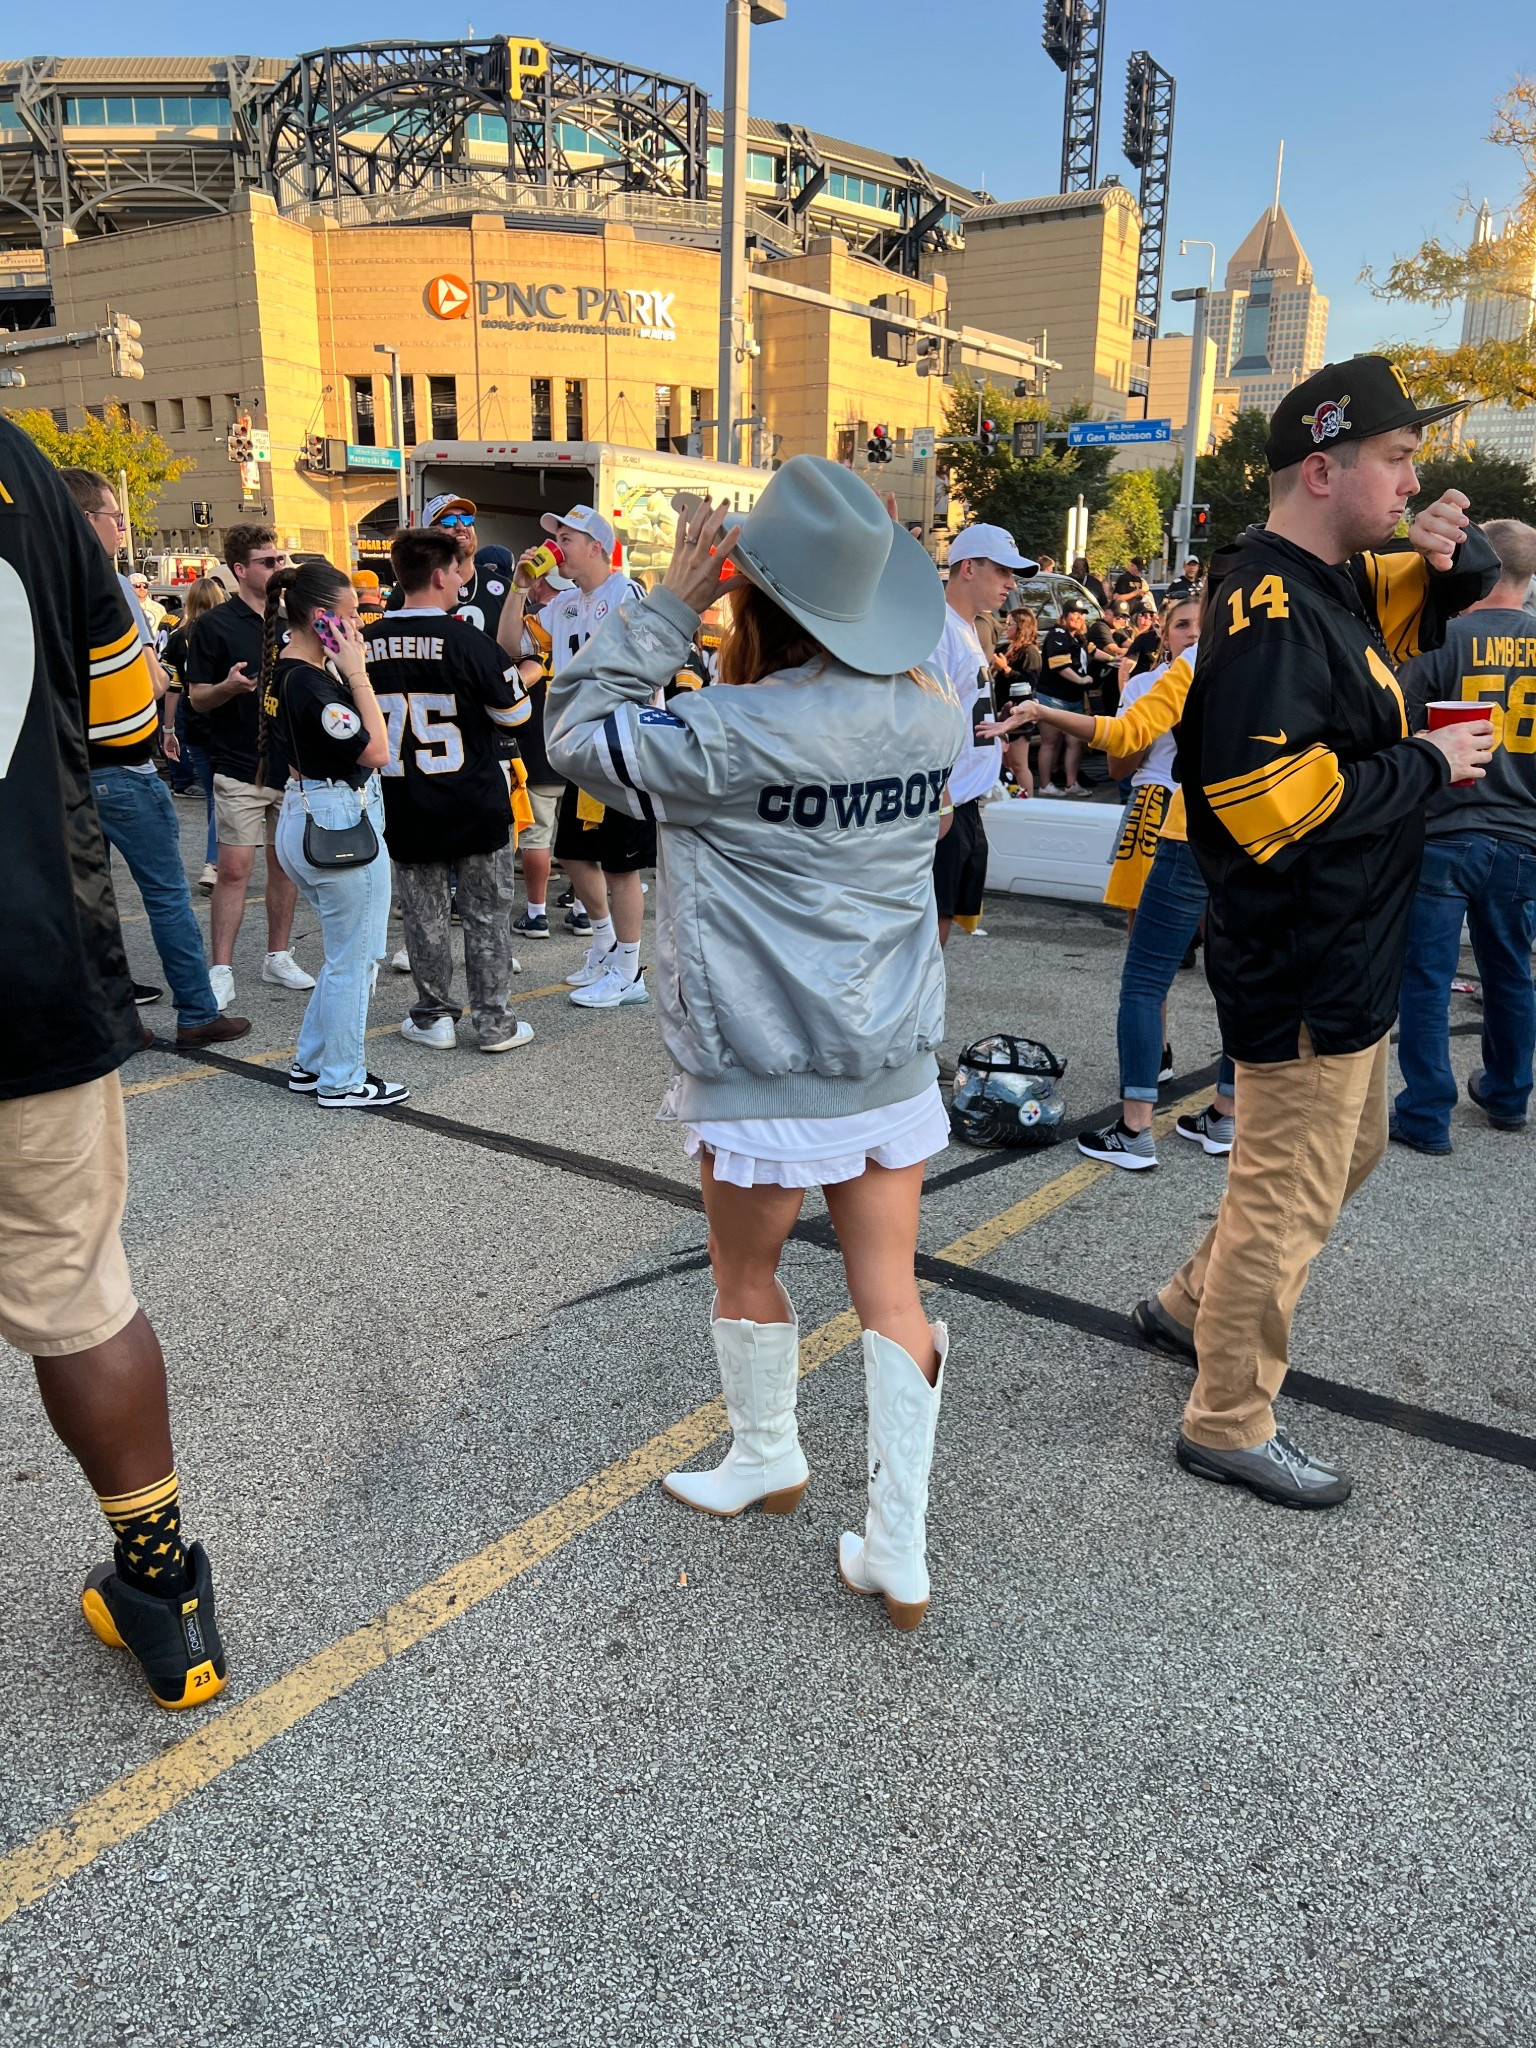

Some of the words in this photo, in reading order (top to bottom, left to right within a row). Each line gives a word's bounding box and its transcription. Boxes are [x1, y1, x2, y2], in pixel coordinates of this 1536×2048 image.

[508, 37, 548, 100] P
[474, 280, 567, 319] PNC
[574, 285, 676, 328] PARK
[481, 320, 515, 329] HOME
[516, 322, 532, 331] OF
[536, 323, 560, 332] THE
[561, 324, 631, 337] PITTSBURGH
[1020, 424, 1035, 432] NO
[1073, 433, 1084, 443] W
[1086, 433, 1106, 443] Gen
[1108, 431, 1152, 442] Robinson
[1155, 429, 1167, 439] St
[350, 455, 380, 465] Mazeroski
[381, 457, 394, 467] Way
[357, 540, 381, 550] EDGAR
[1228, 575, 1290, 636] 14
[366, 636, 445, 663] GREENE
[1472, 636, 1536, 668] LAMBER
[376, 692, 465, 777] 75
[187, 1618, 201, 1651] JORDAN
[193, 1671, 211, 1688] 23
